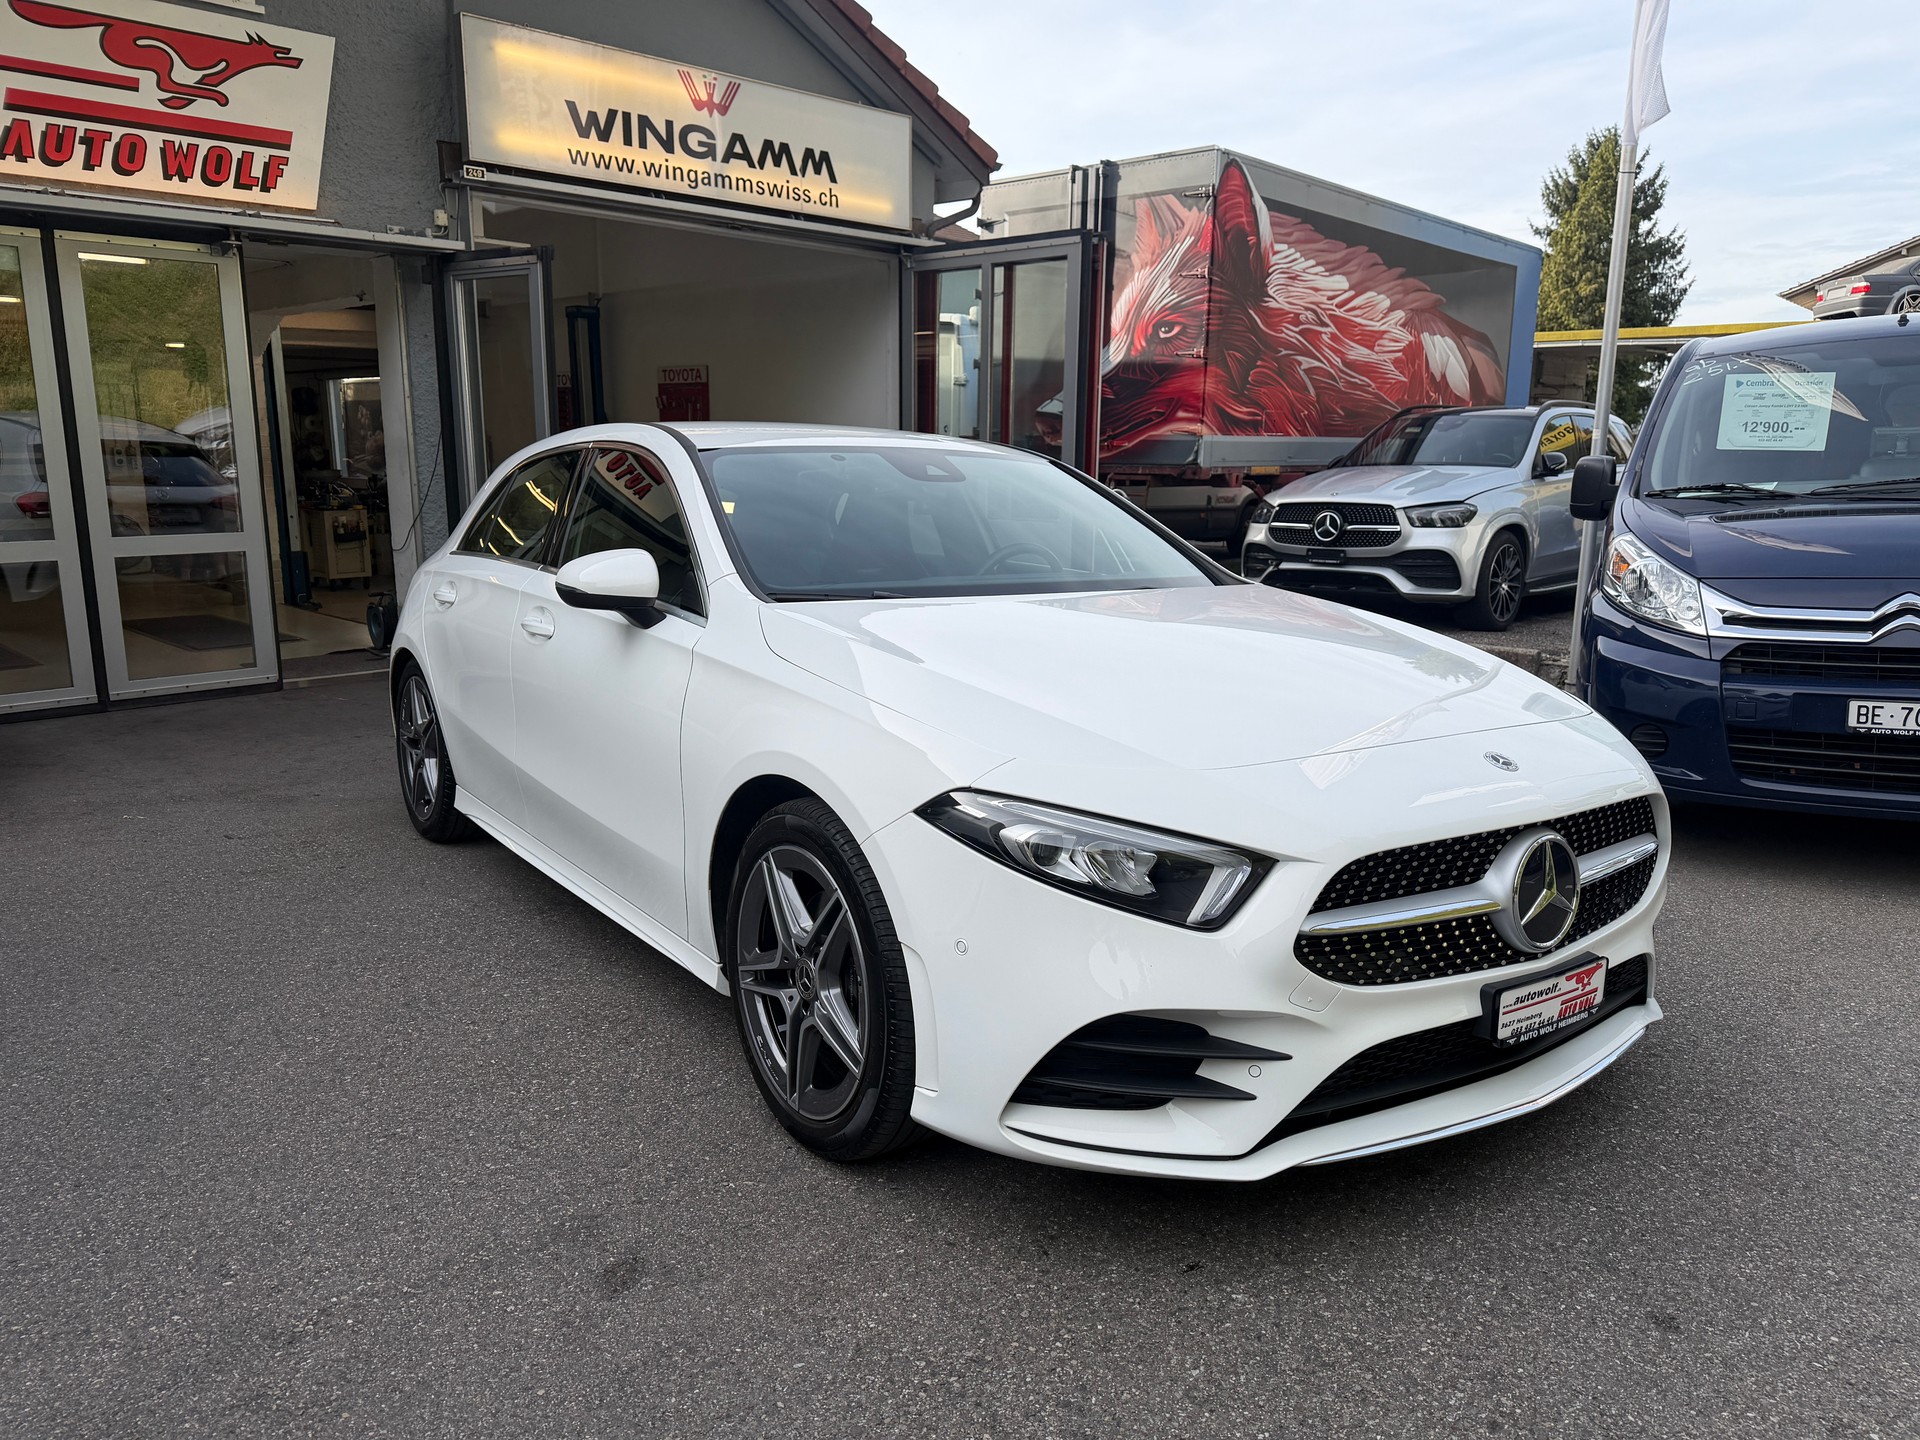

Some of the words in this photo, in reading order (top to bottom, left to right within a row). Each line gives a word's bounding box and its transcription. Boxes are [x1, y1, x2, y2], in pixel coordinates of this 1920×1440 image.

[564, 99, 838, 184] WINGAMM
[1, 118, 147, 177] AUTO
[160, 139, 289, 194] WOLF
[567, 147, 840, 209] www.wingammswiss.ch
[661, 367, 703, 382] TOYOTA
[1745, 379, 1775, 387] Cembra
[1742, 421, 1806, 433] 12'900.--
[1856, 704, 1884, 726] BE
[1515, 1011, 1543, 1025] Heimberg
[1556, 1004, 1578, 1020] AUTO
[1519, 1030, 1539, 1043] AUTO
[1539, 1024, 1557, 1036] WOLF
[1558, 1011, 1589, 1029] HEIMBERG
